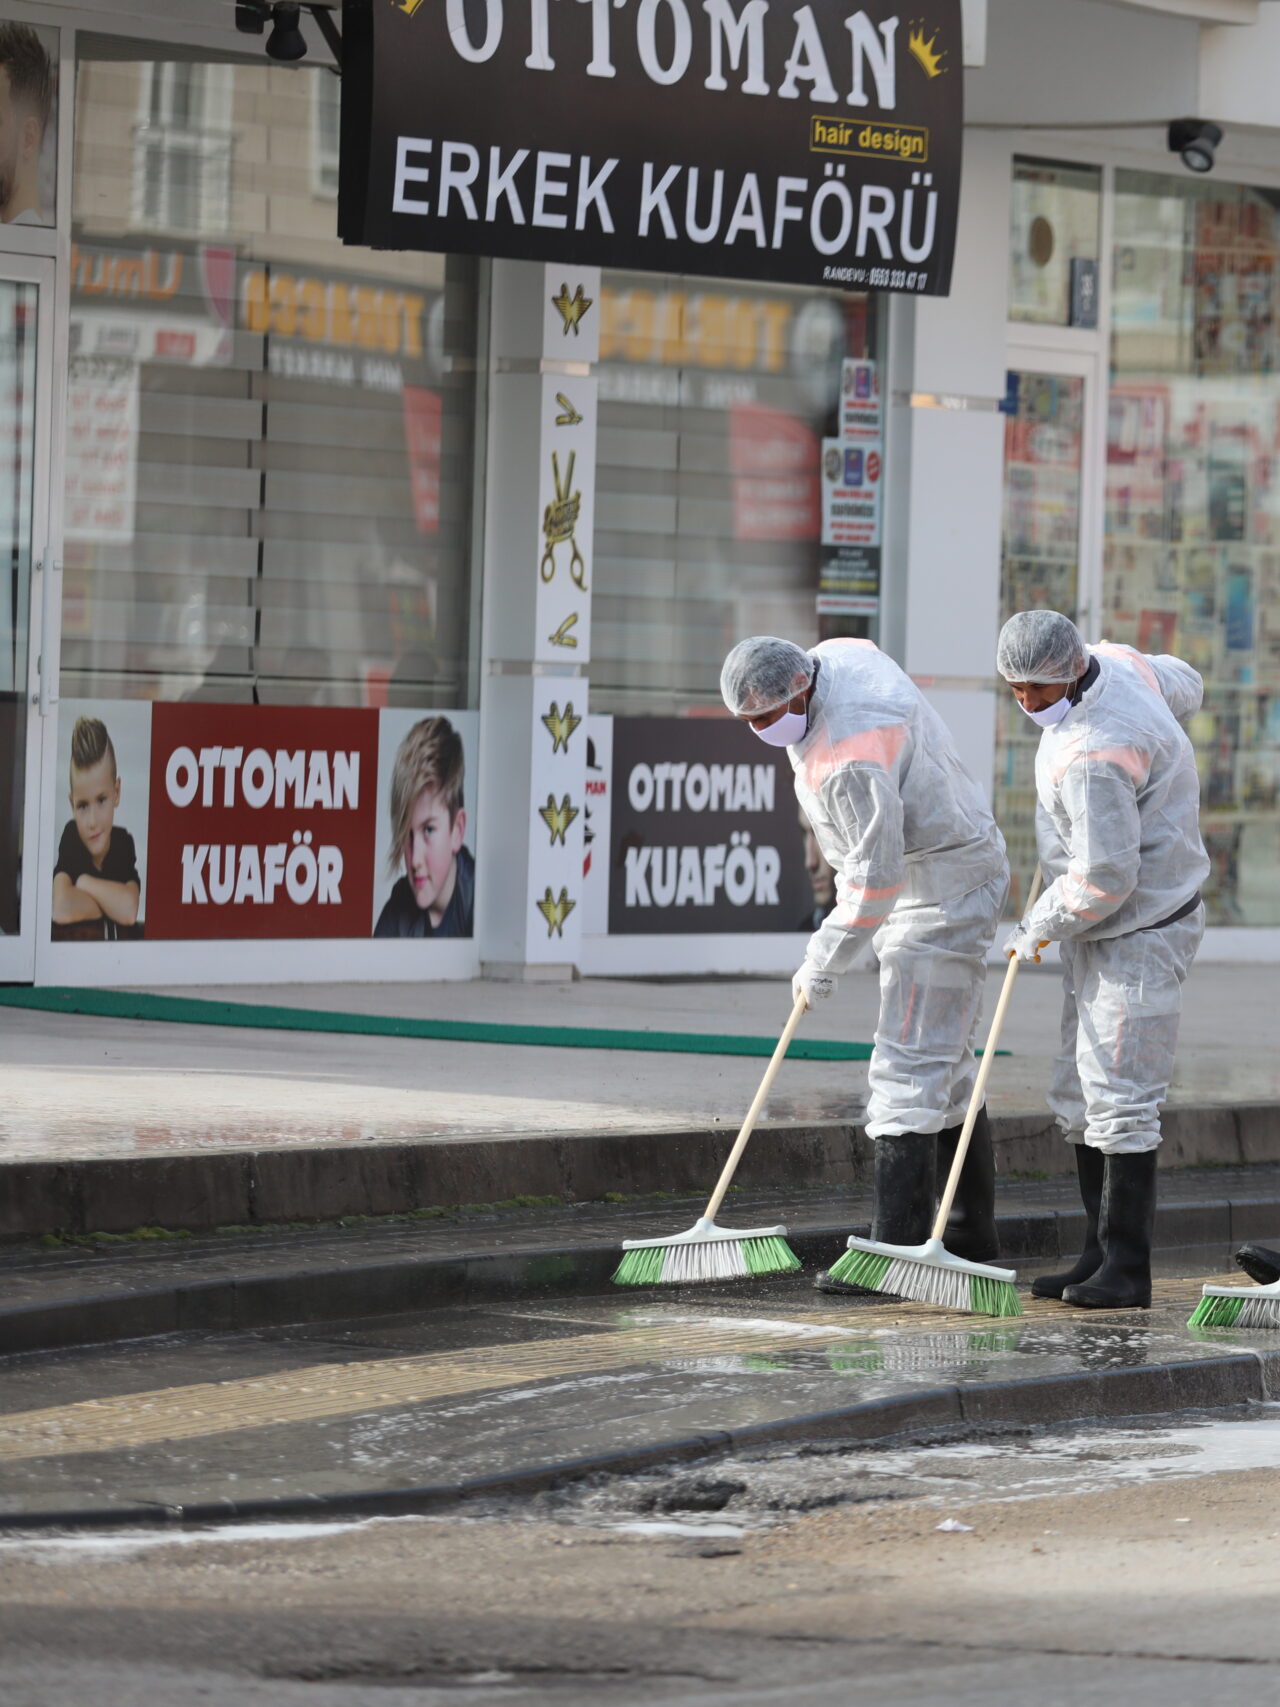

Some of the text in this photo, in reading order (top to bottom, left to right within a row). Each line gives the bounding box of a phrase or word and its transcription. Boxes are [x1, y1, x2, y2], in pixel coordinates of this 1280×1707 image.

[446, 0, 900, 110] OTTOMAN
[814, 119, 924, 157] hair design
[392, 136, 937, 263] ERKEK KUAFÖRÜ
[165, 746, 360, 810] OTTOMAN
[628, 762, 775, 813] OTTOMAN
[181, 831, 343, 906] KUAFÖR
[625, 831, 781, 909] KUAFÖR
